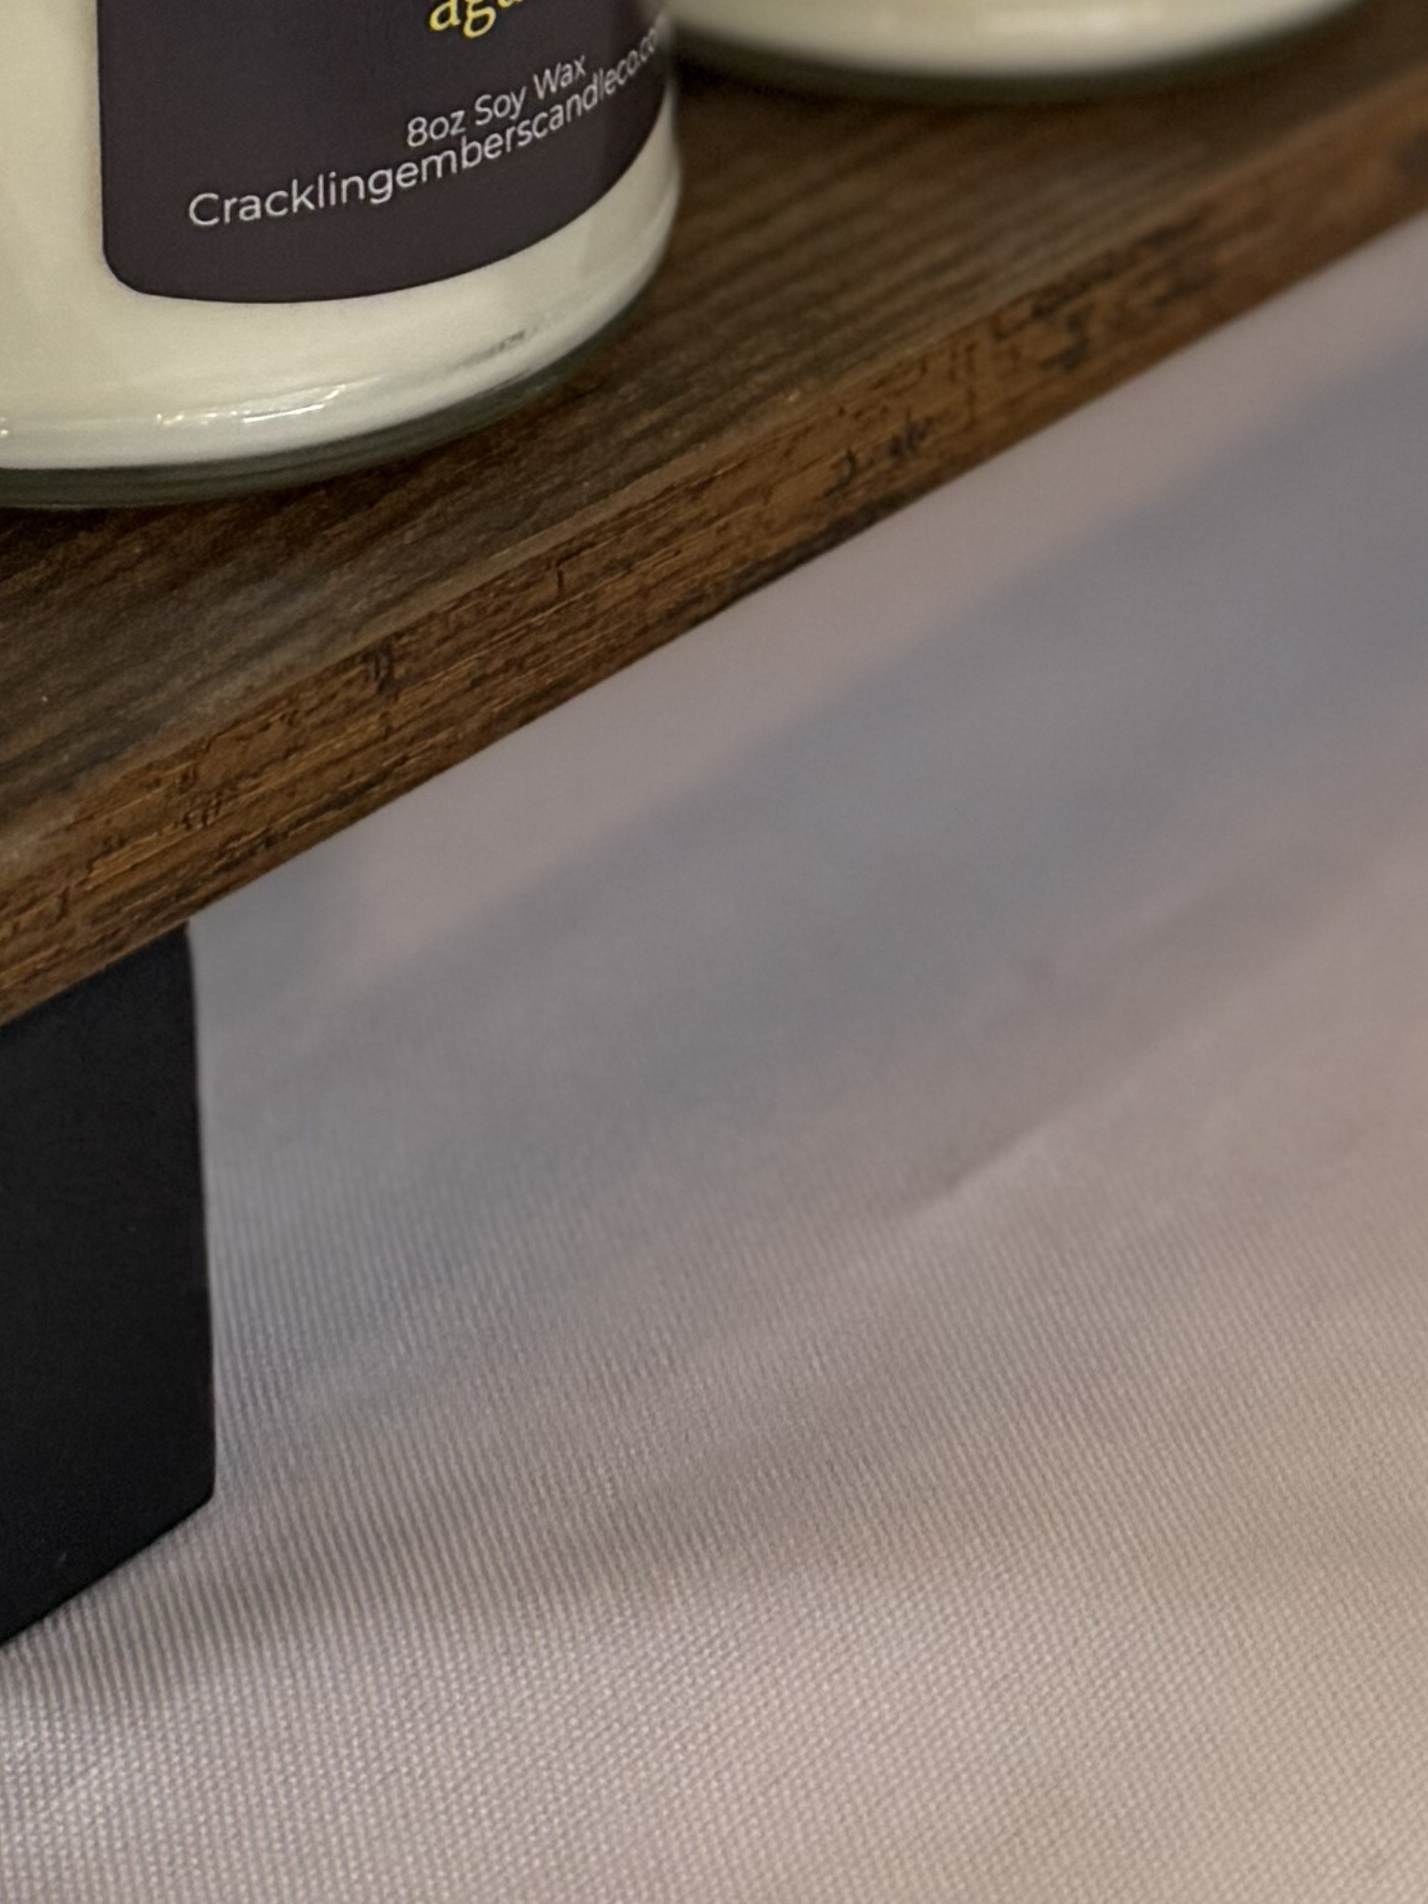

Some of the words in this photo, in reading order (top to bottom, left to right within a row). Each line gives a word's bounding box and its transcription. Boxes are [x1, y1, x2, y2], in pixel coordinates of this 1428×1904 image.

[406, 106, 466, 148] 8oz
[474, 86, 528, 127] Soy
[532, 53, 587, 101] Wax
